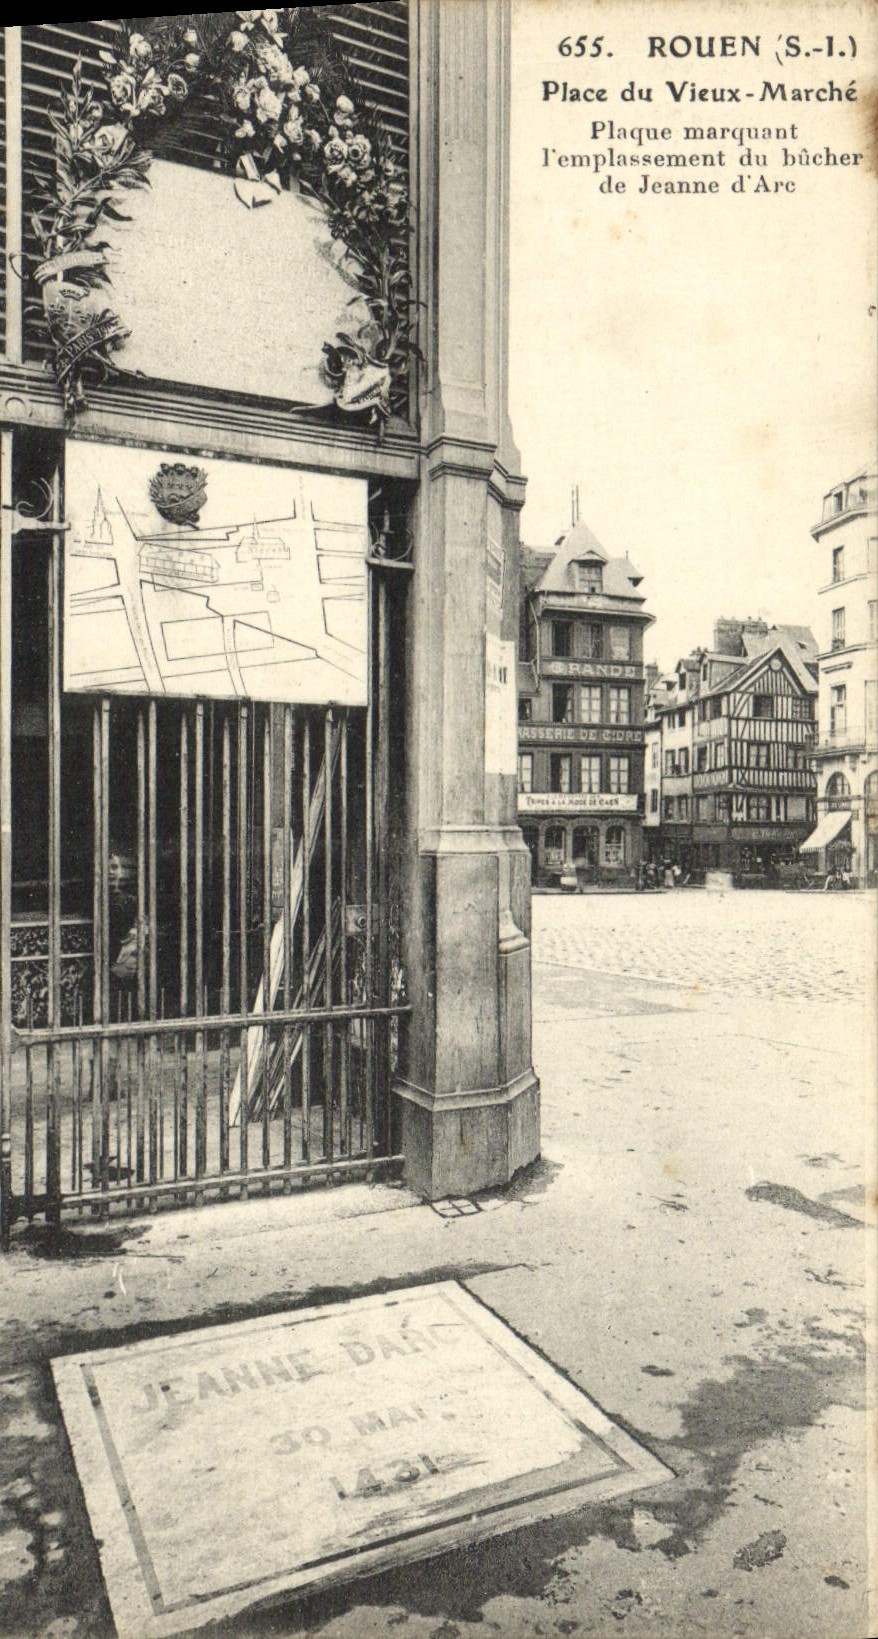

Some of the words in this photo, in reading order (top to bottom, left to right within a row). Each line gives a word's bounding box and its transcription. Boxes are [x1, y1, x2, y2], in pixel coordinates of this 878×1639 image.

[64, 333, 95, 359] PARIS
[551, 662, 636, 678] GRANDE
[579, 730, 597, 740] DE
[602, 730, 642, 742] CIDRE
[130, 1348, 318, 1413] JEANNE
[269, 1425, 331, 1456] 30
[329, 1453, 440, 1500] 1431
